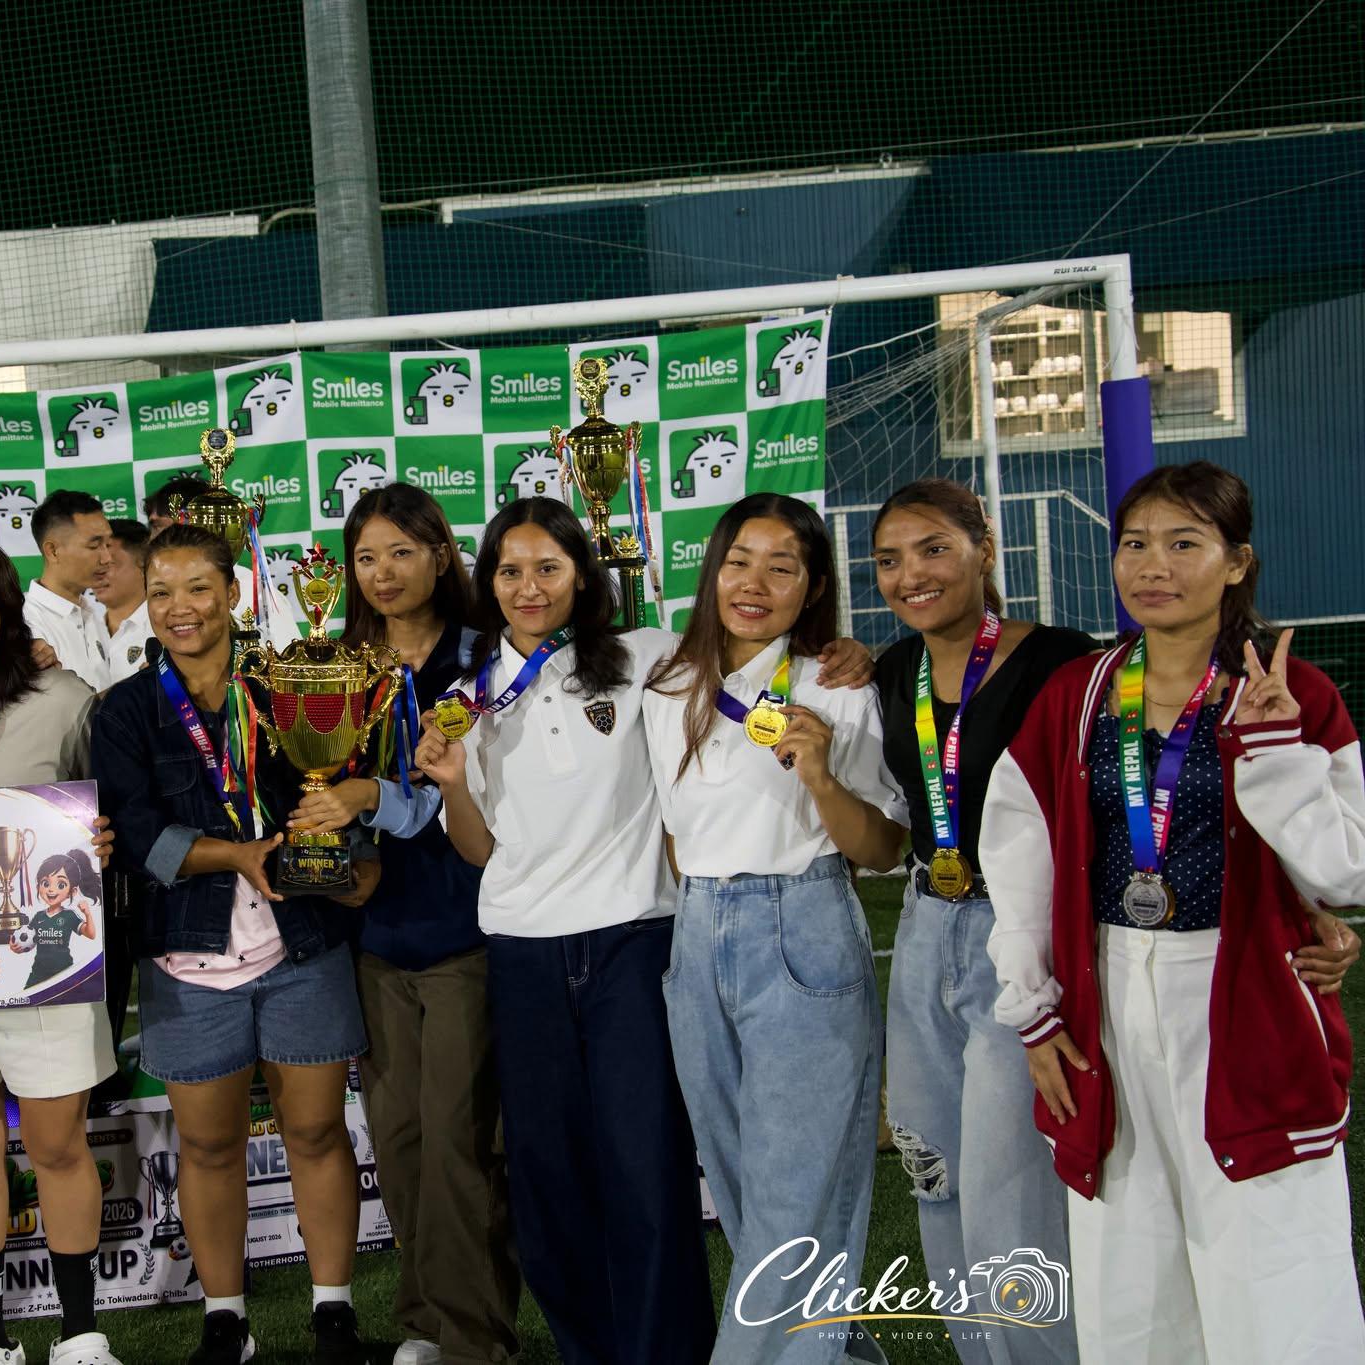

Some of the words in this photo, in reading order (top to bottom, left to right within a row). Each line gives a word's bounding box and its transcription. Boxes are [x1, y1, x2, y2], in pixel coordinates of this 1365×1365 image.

[667, 356, 738, 380] Smiles
[312, 377, 383, 399] Smiles
[490, 373, 562, 395] Smiles
[667, 381, 693, 390] Mobile
[694, 376, 738, 387] Remittance
[313, 400, 339, 408] Mobile
[491, 395, 516, 403] Mobile
[518, 394, 562, 402] Remittance
[139, 399, 209, 423] Smiles
[140, 423, 166, 432] Mobile
[167, 418, 209, 428] Remittance
[754, 433, 818, 460] Smiles
[753, 459, 777, 469] Mobile
[778, 454, 819, 465] Remittance
[232, 475, 300, 498] Smiles
[405, 466, 476, 487] Smiles
[265, 496, 301, 505] emittance
[433, 488, 476, 496] Remittance
[672, 535, 711, 560] Smi
[671, 561, 695, 570] Mobile
[503, 688, 519, 704] MY
[918, 681, 930, 699] MY
[189, 724, 211, 752] PRIDE
[205, 753, 217, 769] MY
[945, 736, 958, 776] PRIDE
[1123, 739, 1142, 782] NEPAL
[928, 775, 946, 818] NEPAL
[1129, 782, 1145, 808] MY
[1152, 787, 1171, 810] MY
[933, 817, 950, 839] MY
[298, 858, 334, 869] WINNER
[38, 928, 63, 937] Smiles
[8, 996, 30, 1004] Chiba
[104, 1202, 135, 1221] 2026
[268, 1233, 281, 1241] 2026
[249, 1255, 307, 1268] ROTHERHOOD,
[357, 1243, 382, 1252] EALTH
[2, 1304, 26, 1314] enue:
[107, 1292, 161, 1305] Tokiwadaira,
[162, 1290, 188, 1299] Chiba
